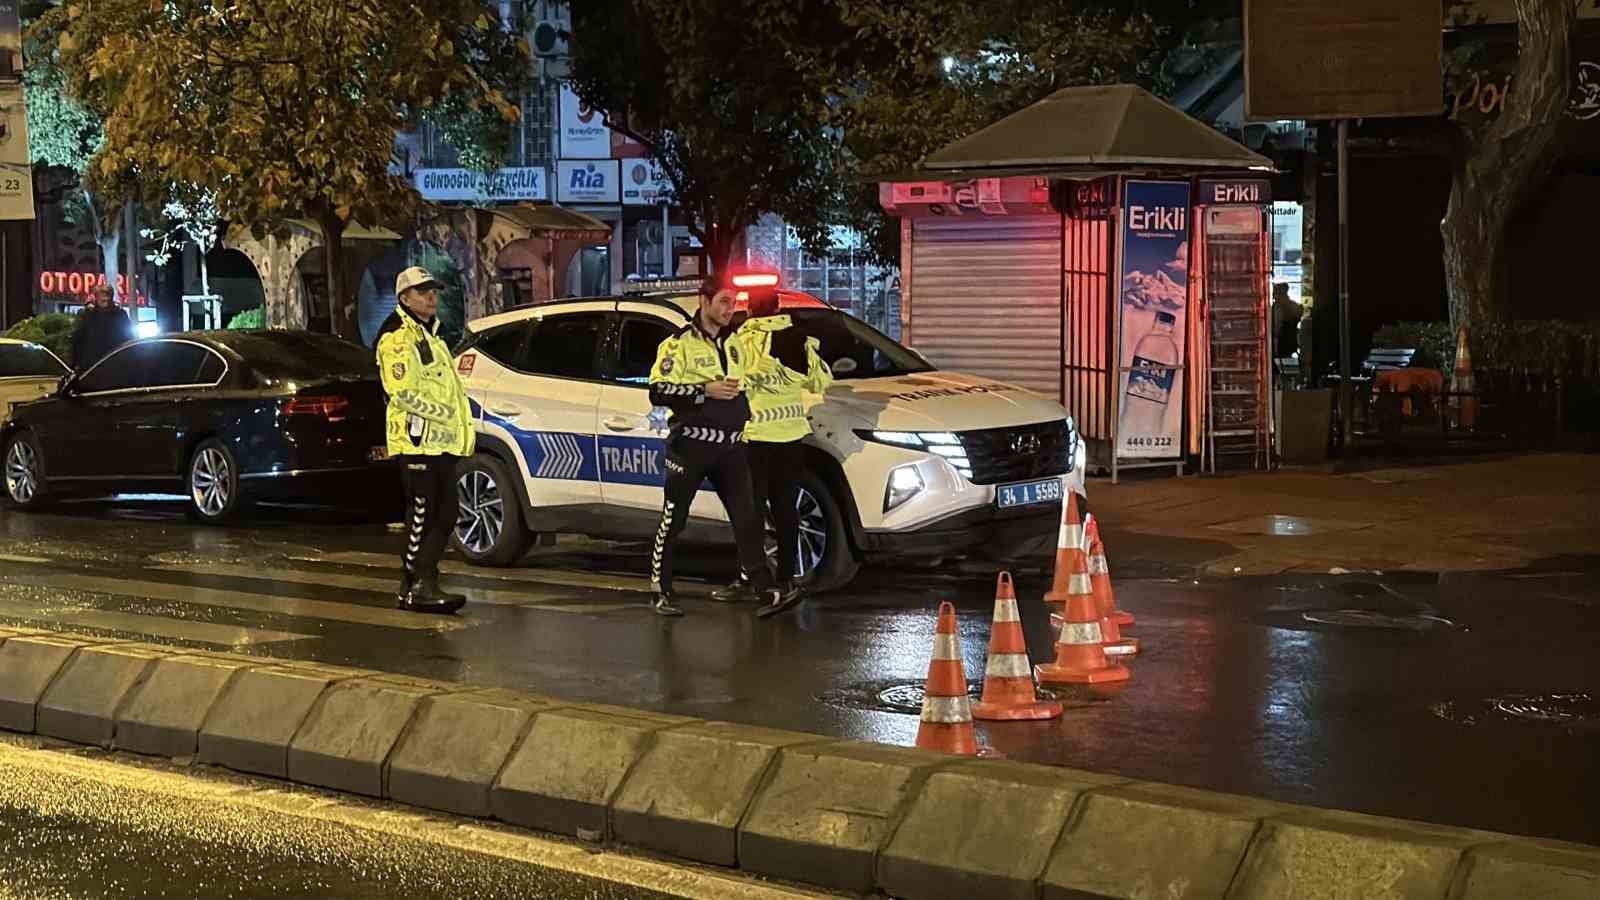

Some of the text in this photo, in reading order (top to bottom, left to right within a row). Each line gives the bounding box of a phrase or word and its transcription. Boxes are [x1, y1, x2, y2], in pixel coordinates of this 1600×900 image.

[5, 179, 20, 191] 23
[423, 171, 477, 189] GÜNDOĞDU
[570, 163, 604, 188] Ria
[1214, 183, 1260, 202] Erikli
[1129, 205, 1185, 231] Erikli
[1127, 438, 1144, 446] 444
[1154, 437, 1172, 446] 222
[602, 445, 660, 475] TRAFİK
[1003, 482, 1059, 505] 34 A 5589
